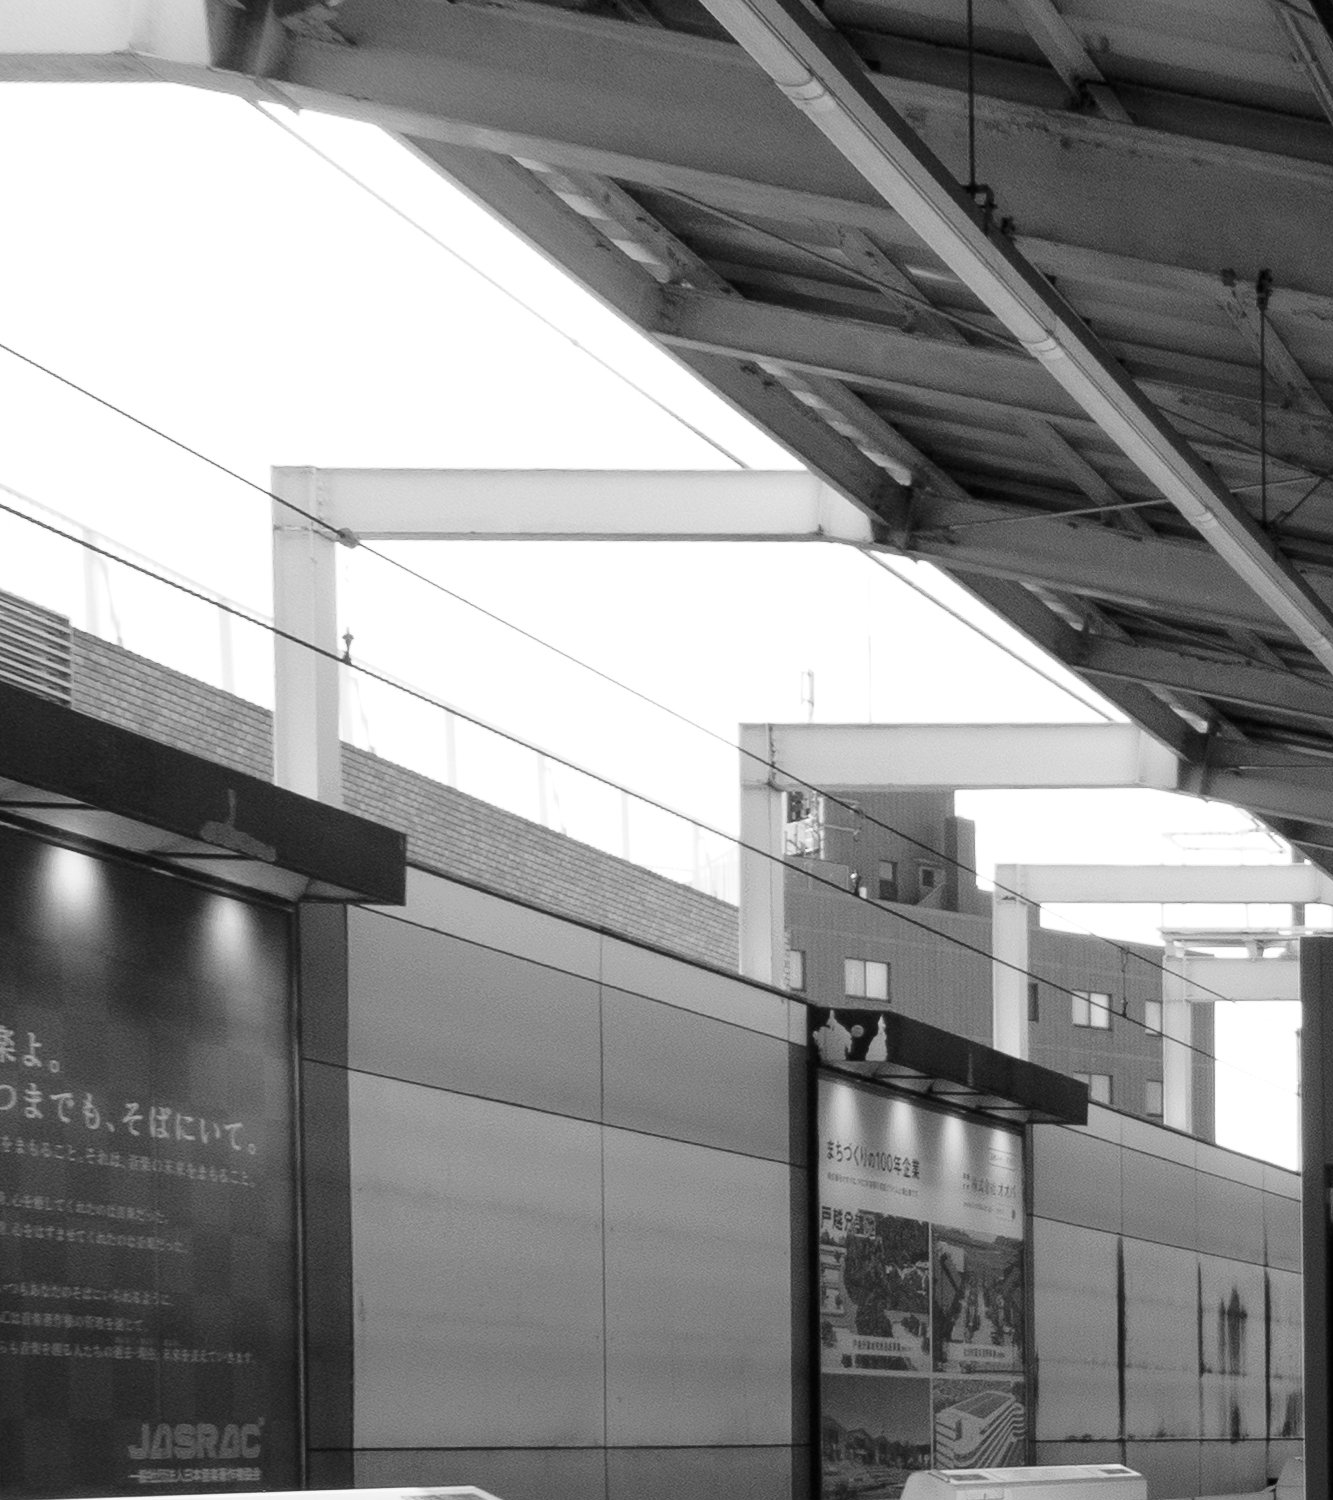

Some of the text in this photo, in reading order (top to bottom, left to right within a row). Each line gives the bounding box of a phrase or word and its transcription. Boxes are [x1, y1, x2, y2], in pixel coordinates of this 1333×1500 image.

[826, 1140, 921, 1181] まちづくりの100年企業
[128, 1423, 262, 1460] JASRAC
